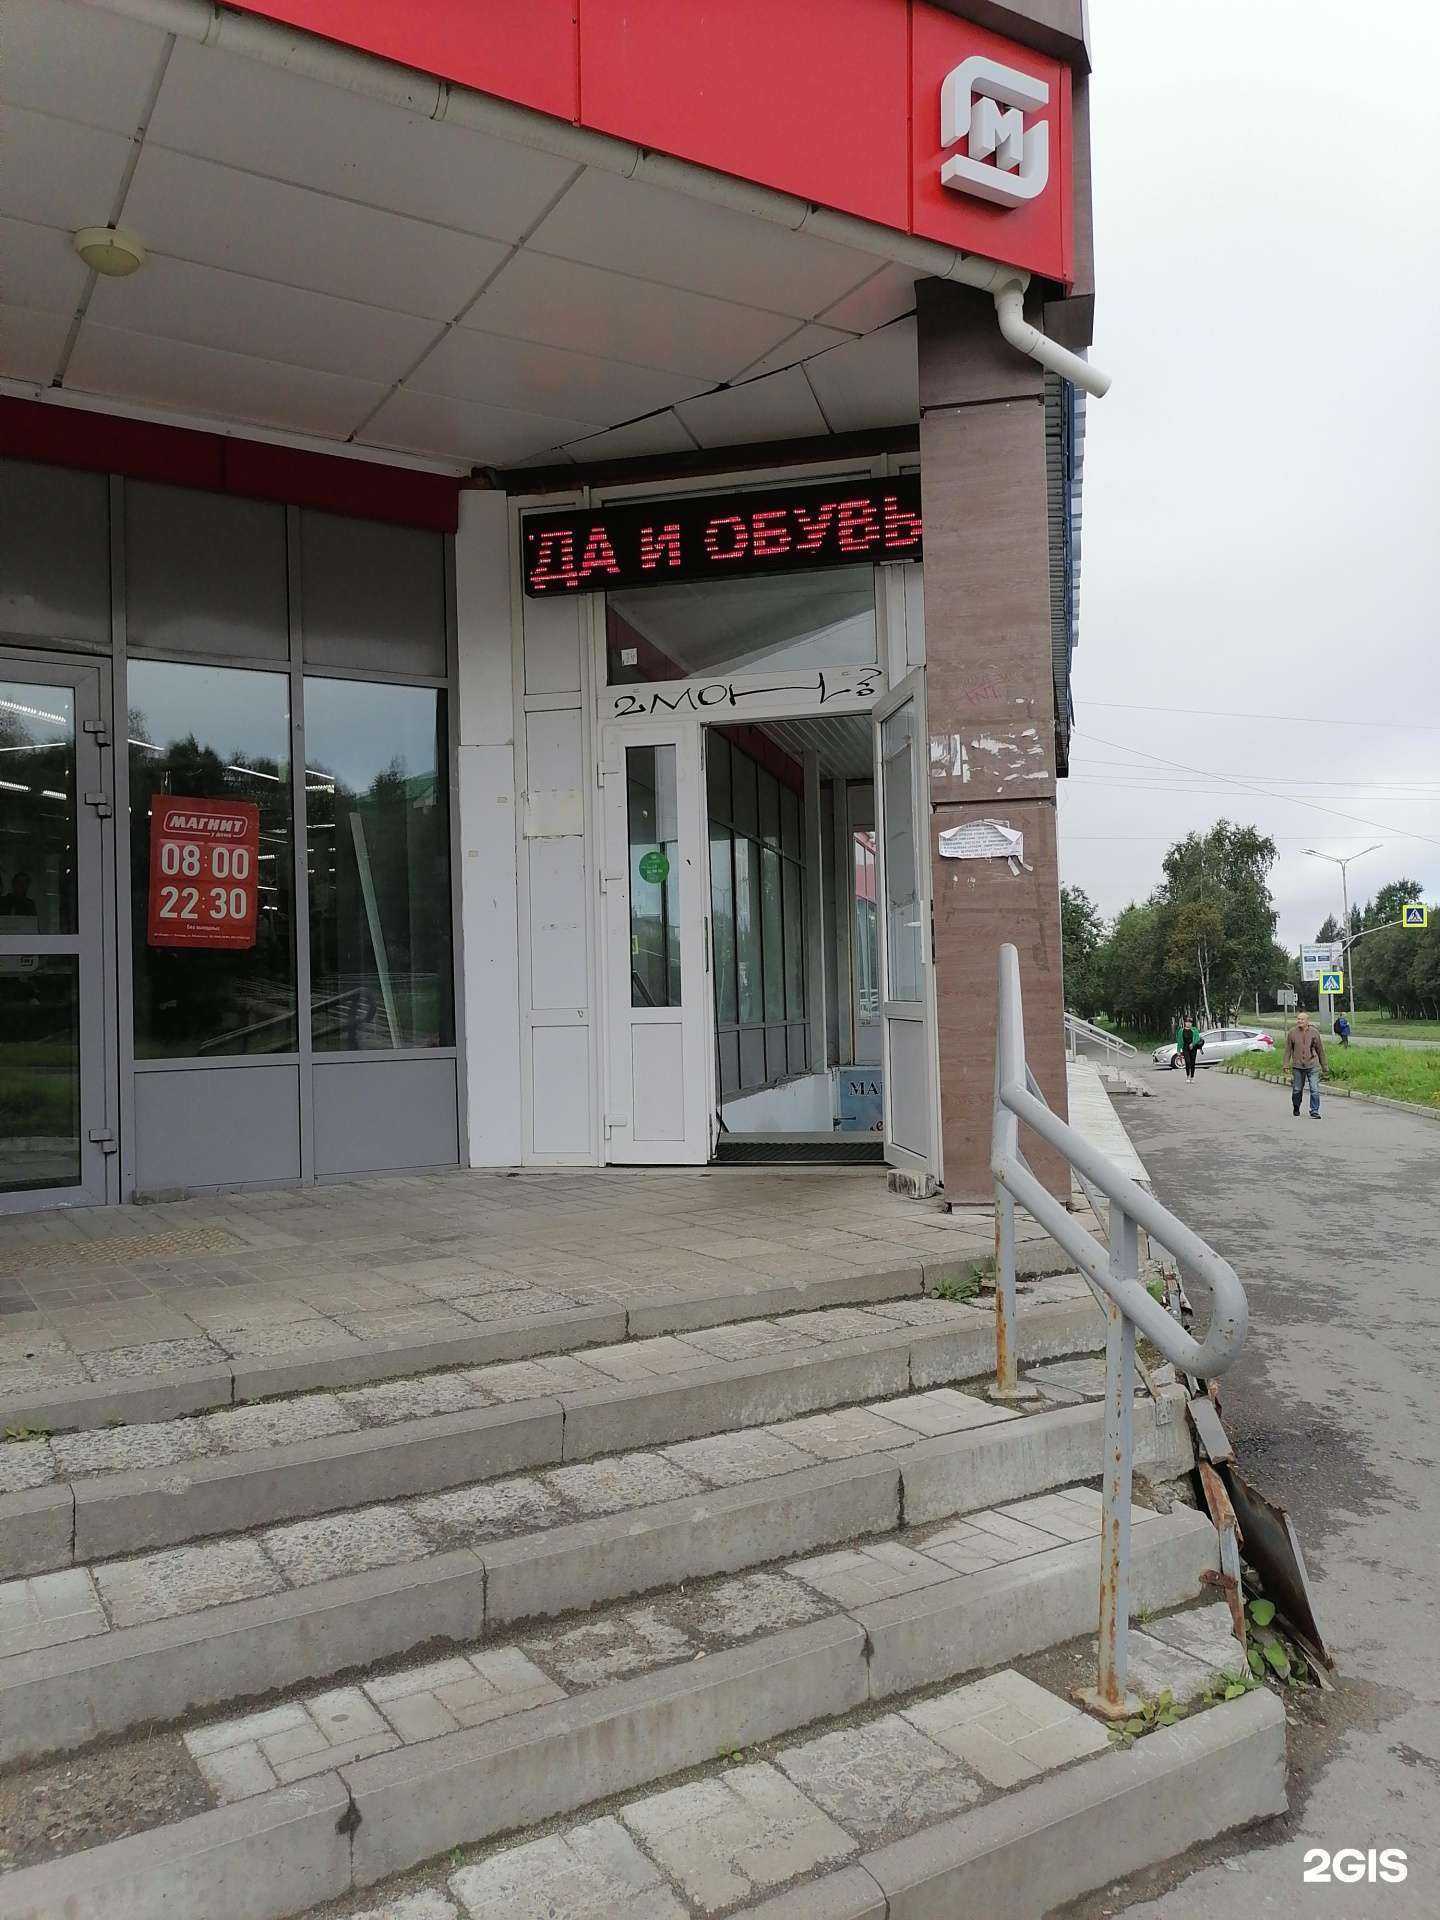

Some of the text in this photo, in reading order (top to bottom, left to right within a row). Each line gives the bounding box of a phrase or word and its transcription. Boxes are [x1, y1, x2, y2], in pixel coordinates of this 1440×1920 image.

[529, 496, 923, 590] ДА И ОБУВЬ
[170, 815, 243, 832] МАГНИТ
[849, 1081, 884, 1095] МА
